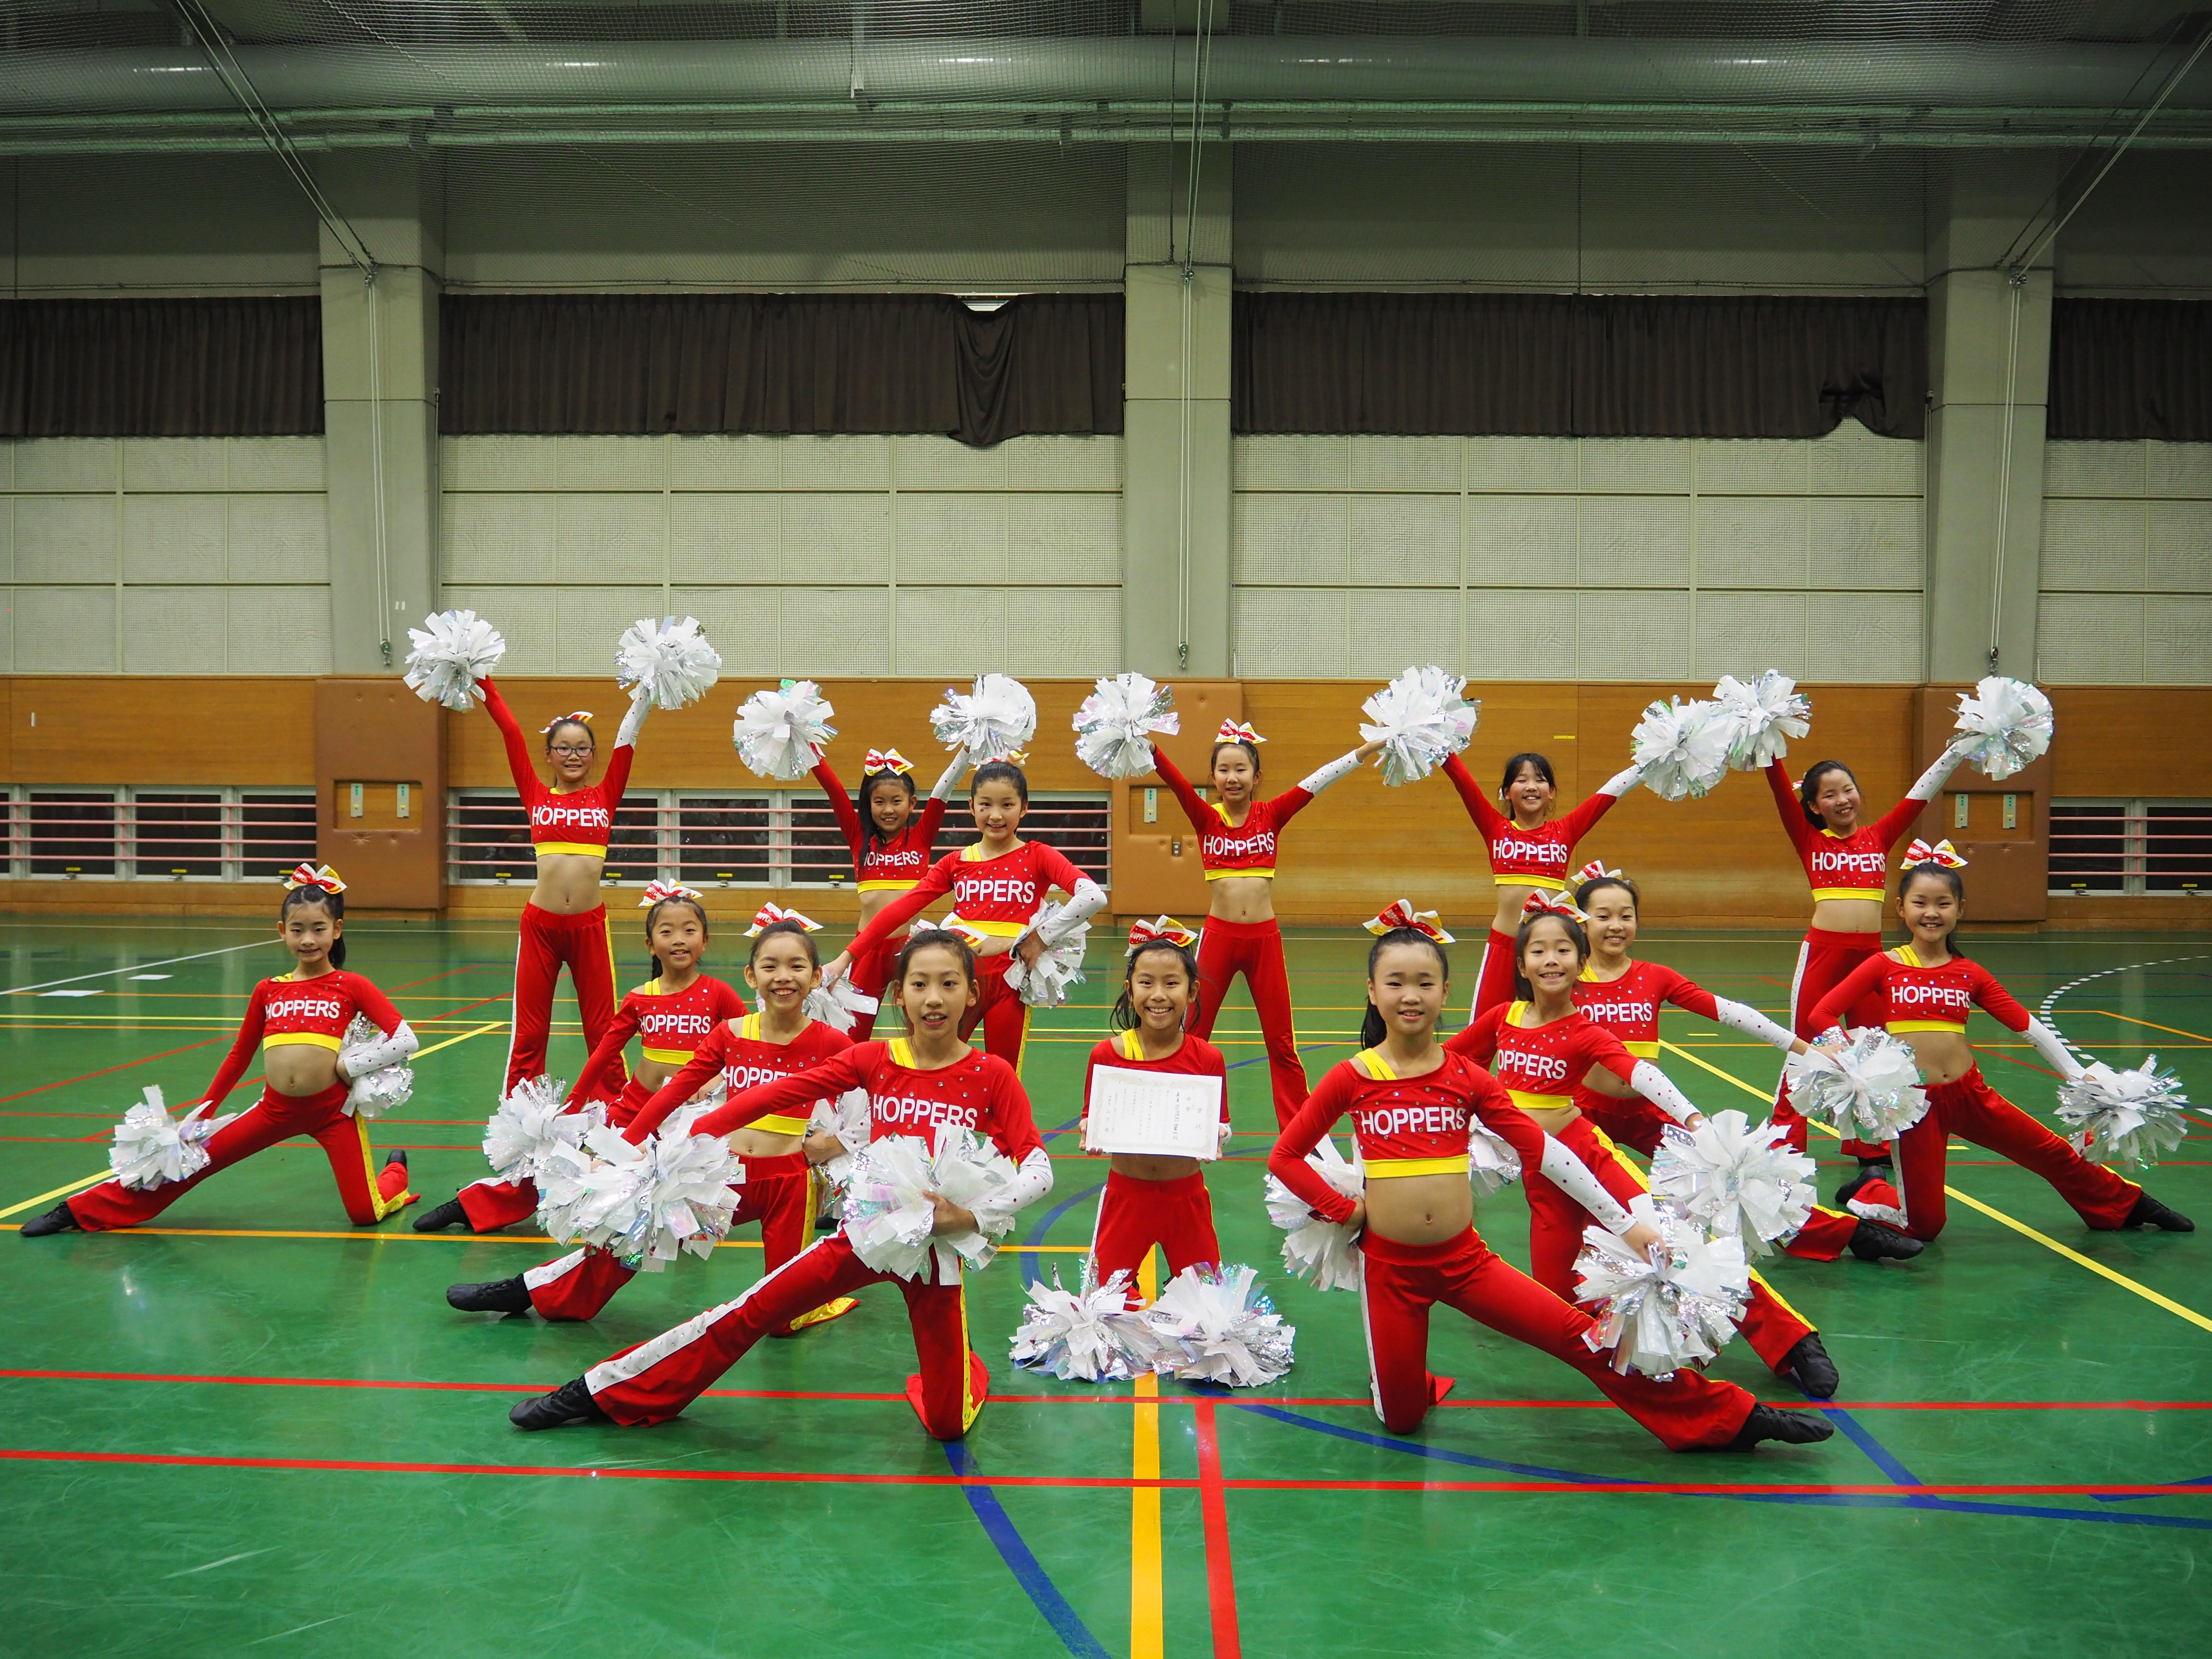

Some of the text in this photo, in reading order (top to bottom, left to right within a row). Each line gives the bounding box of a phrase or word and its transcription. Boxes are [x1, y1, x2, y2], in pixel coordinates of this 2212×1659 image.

[532, 806, 609, 828] HOPPERS
[1203, 832, 1274, 856] HOPPERS
[1493, 839, 1567, 864] HOPPERS
[1812, 852, 1886, 873] HOPPERS
[954, 880, 1035, 903] OPPERS
[1891, 986, 1971, 1009] HOPPERS
[264, 999, 341, 1020] HOPPERS
[1577, 1002, 1653, 1022] OPPERS
[873, 1093, 978, 1130] HOPPERS
[1360, 1106, 1466, 1135] HOPPERS
